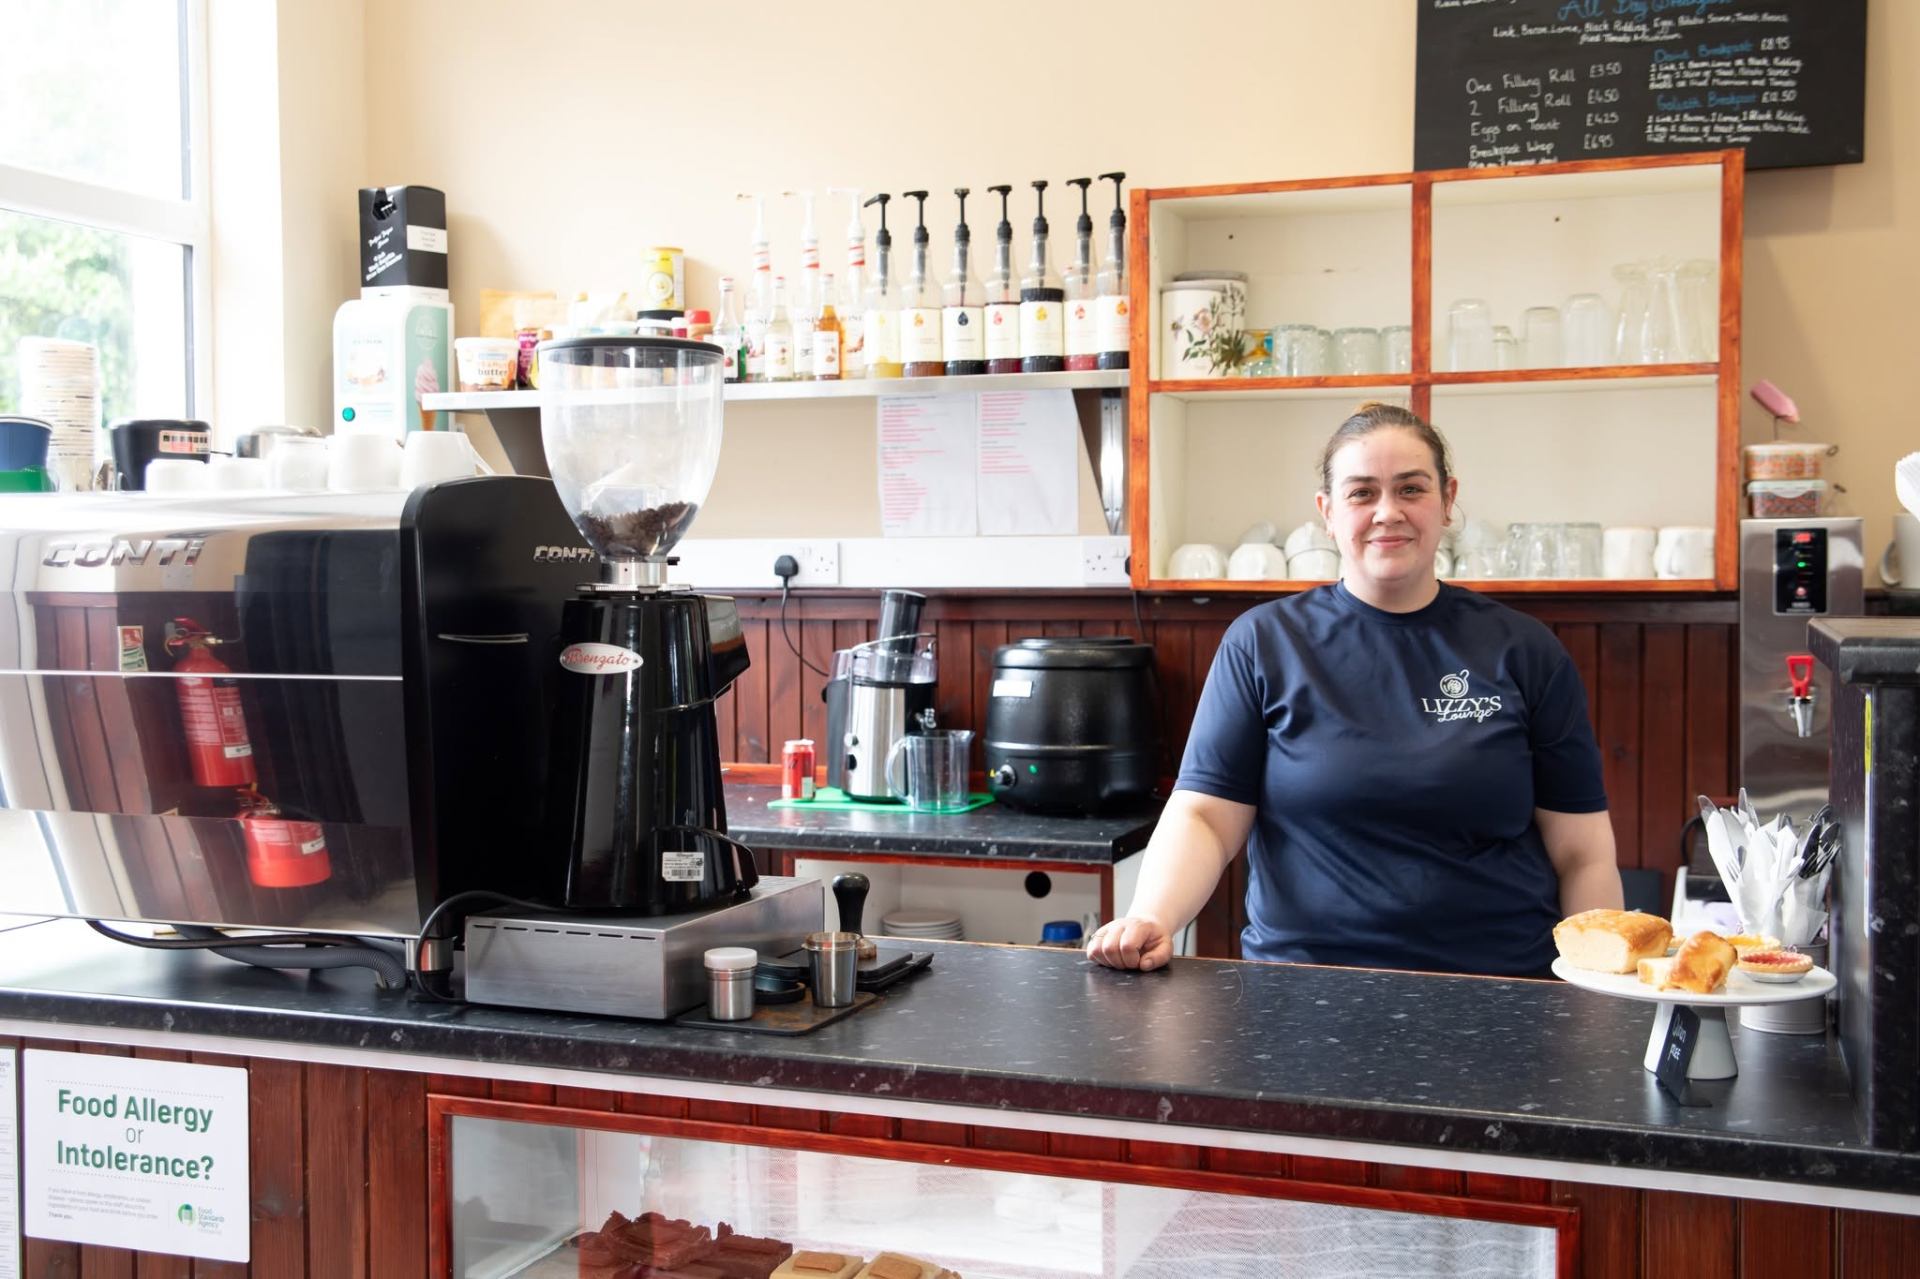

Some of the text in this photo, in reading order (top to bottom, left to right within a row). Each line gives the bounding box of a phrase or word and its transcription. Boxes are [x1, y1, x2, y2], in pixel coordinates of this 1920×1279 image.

[1466, 78, 1492, 94] One
[1503, 74, 1541, 97] Filling
[1549, 69, 1576, 83] Roll
[1469, 101, 1482, 116] 2
[1498, 97, 1539, 122] Filling
[1544, 93, 1572, 107] Roll
[1471, 121, 1501, 143] Eggs
[1506, 123, 1522, 132] on
[1529, 119, 1560, 131] Toast
[1470, 145, 1520, 163] Breakfast
[1421, 696, 1502, 713] LIZZY'S
[1437, 708, 1494, 723] Lounge
[58, 1089, 213, 1133] Food Allergy
[126, 1127, 144, 1143] or
[57, 1140, 214, 1181] Intolerance?
